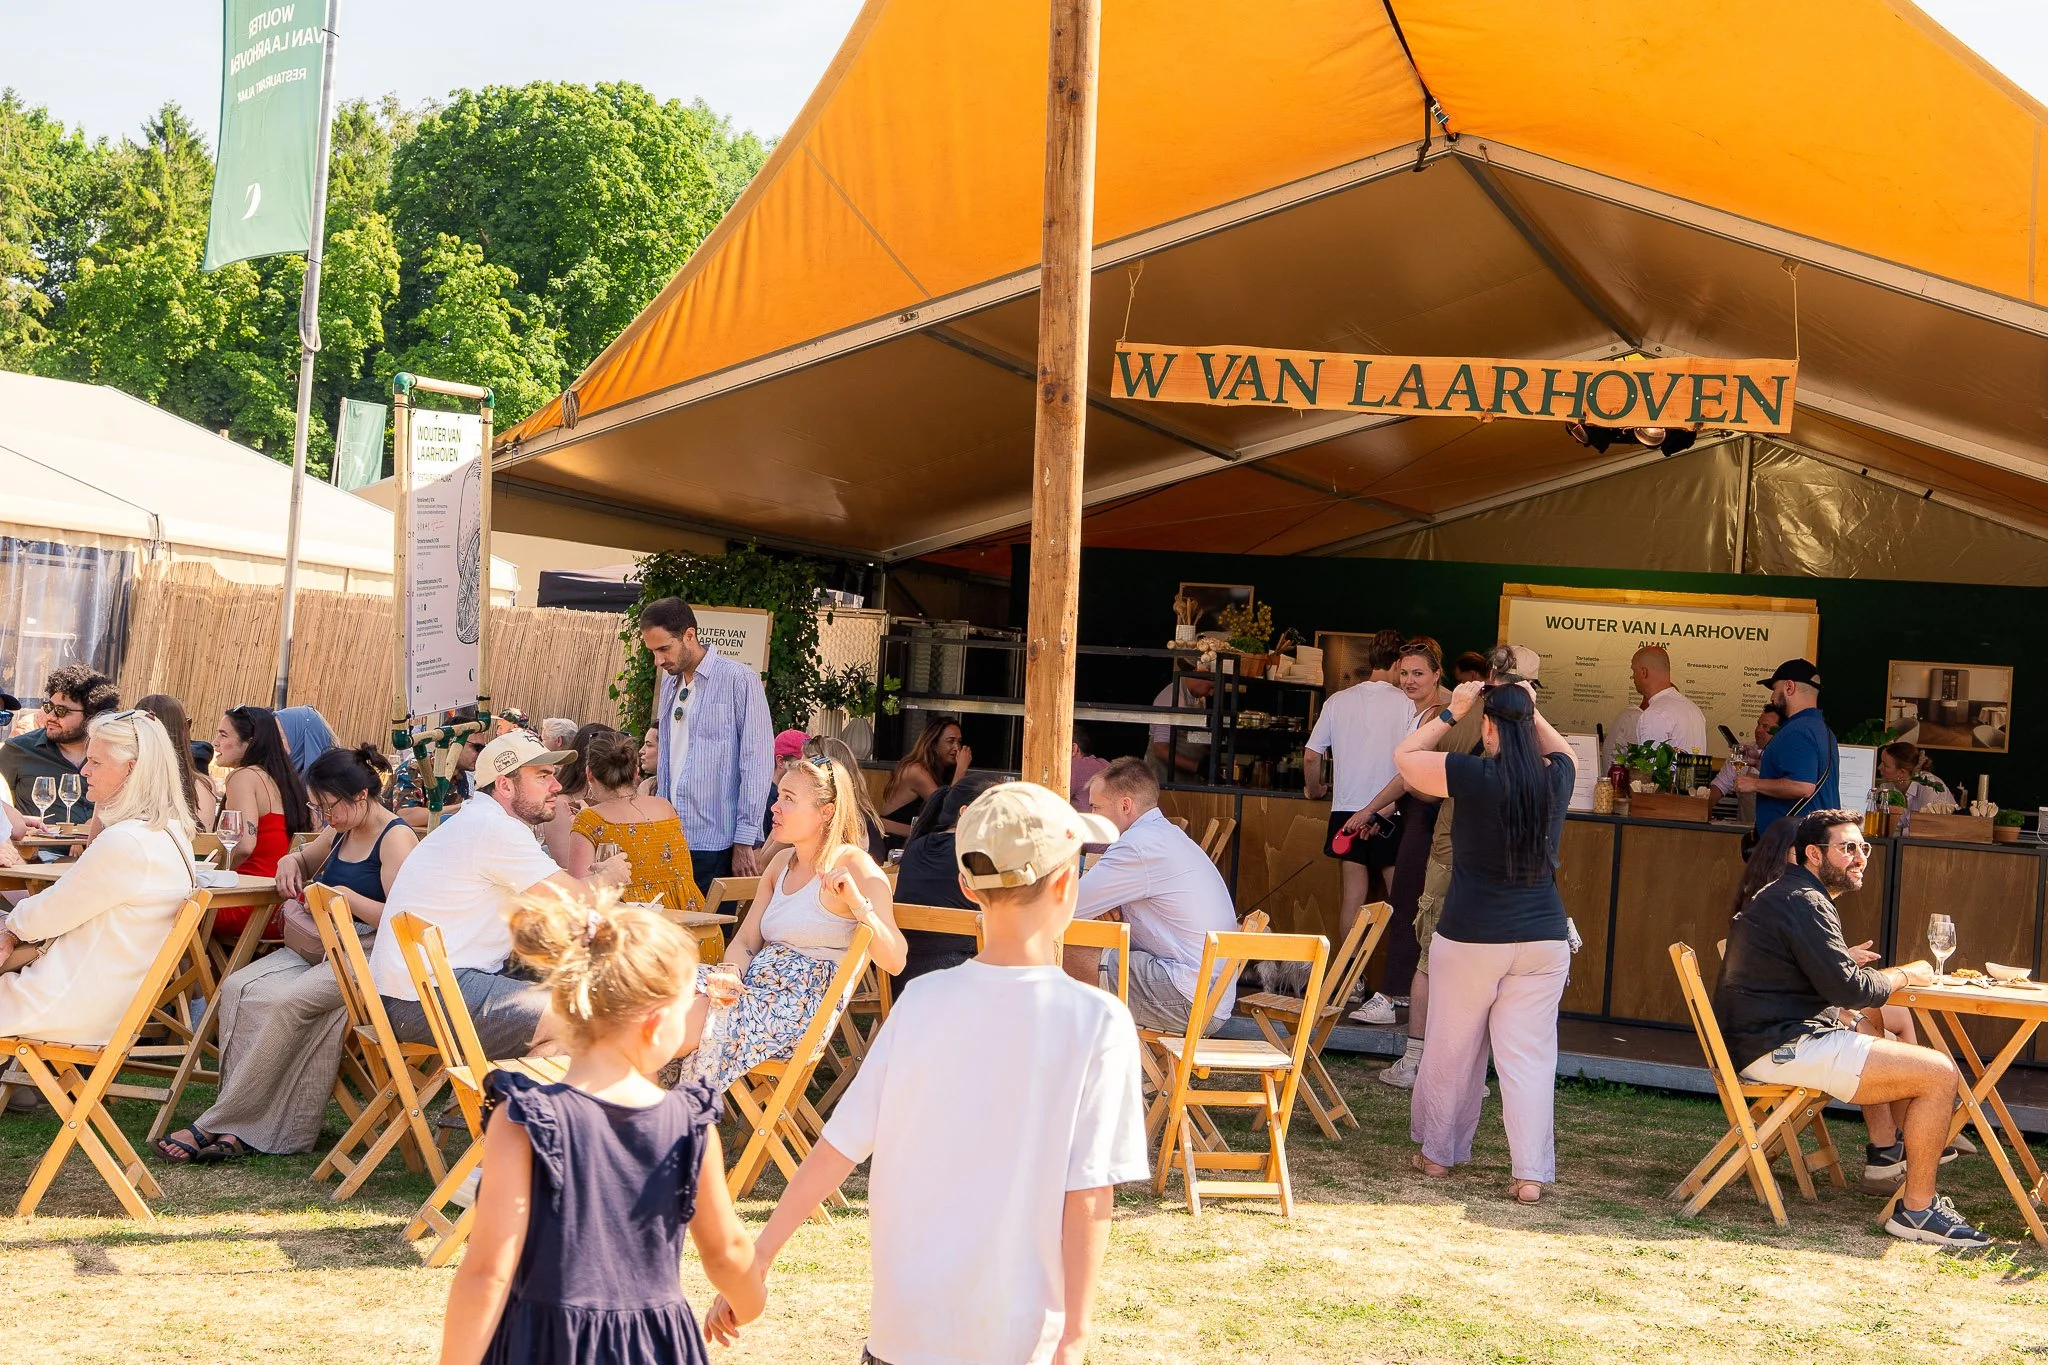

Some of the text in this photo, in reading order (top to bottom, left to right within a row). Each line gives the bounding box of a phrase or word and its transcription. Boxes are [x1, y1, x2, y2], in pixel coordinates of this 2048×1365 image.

[1115, 351, 1790, 426] W VAN LAARHOVEN
[417, 425, 461, 443] WOUTER VAN
[417, 445, 459, 462] LAARHOVEN
[697, 628, 746, 638] OUTER VAN
[1545, 616, 1769, 641] WOUTER VAN LAARHOVEN
